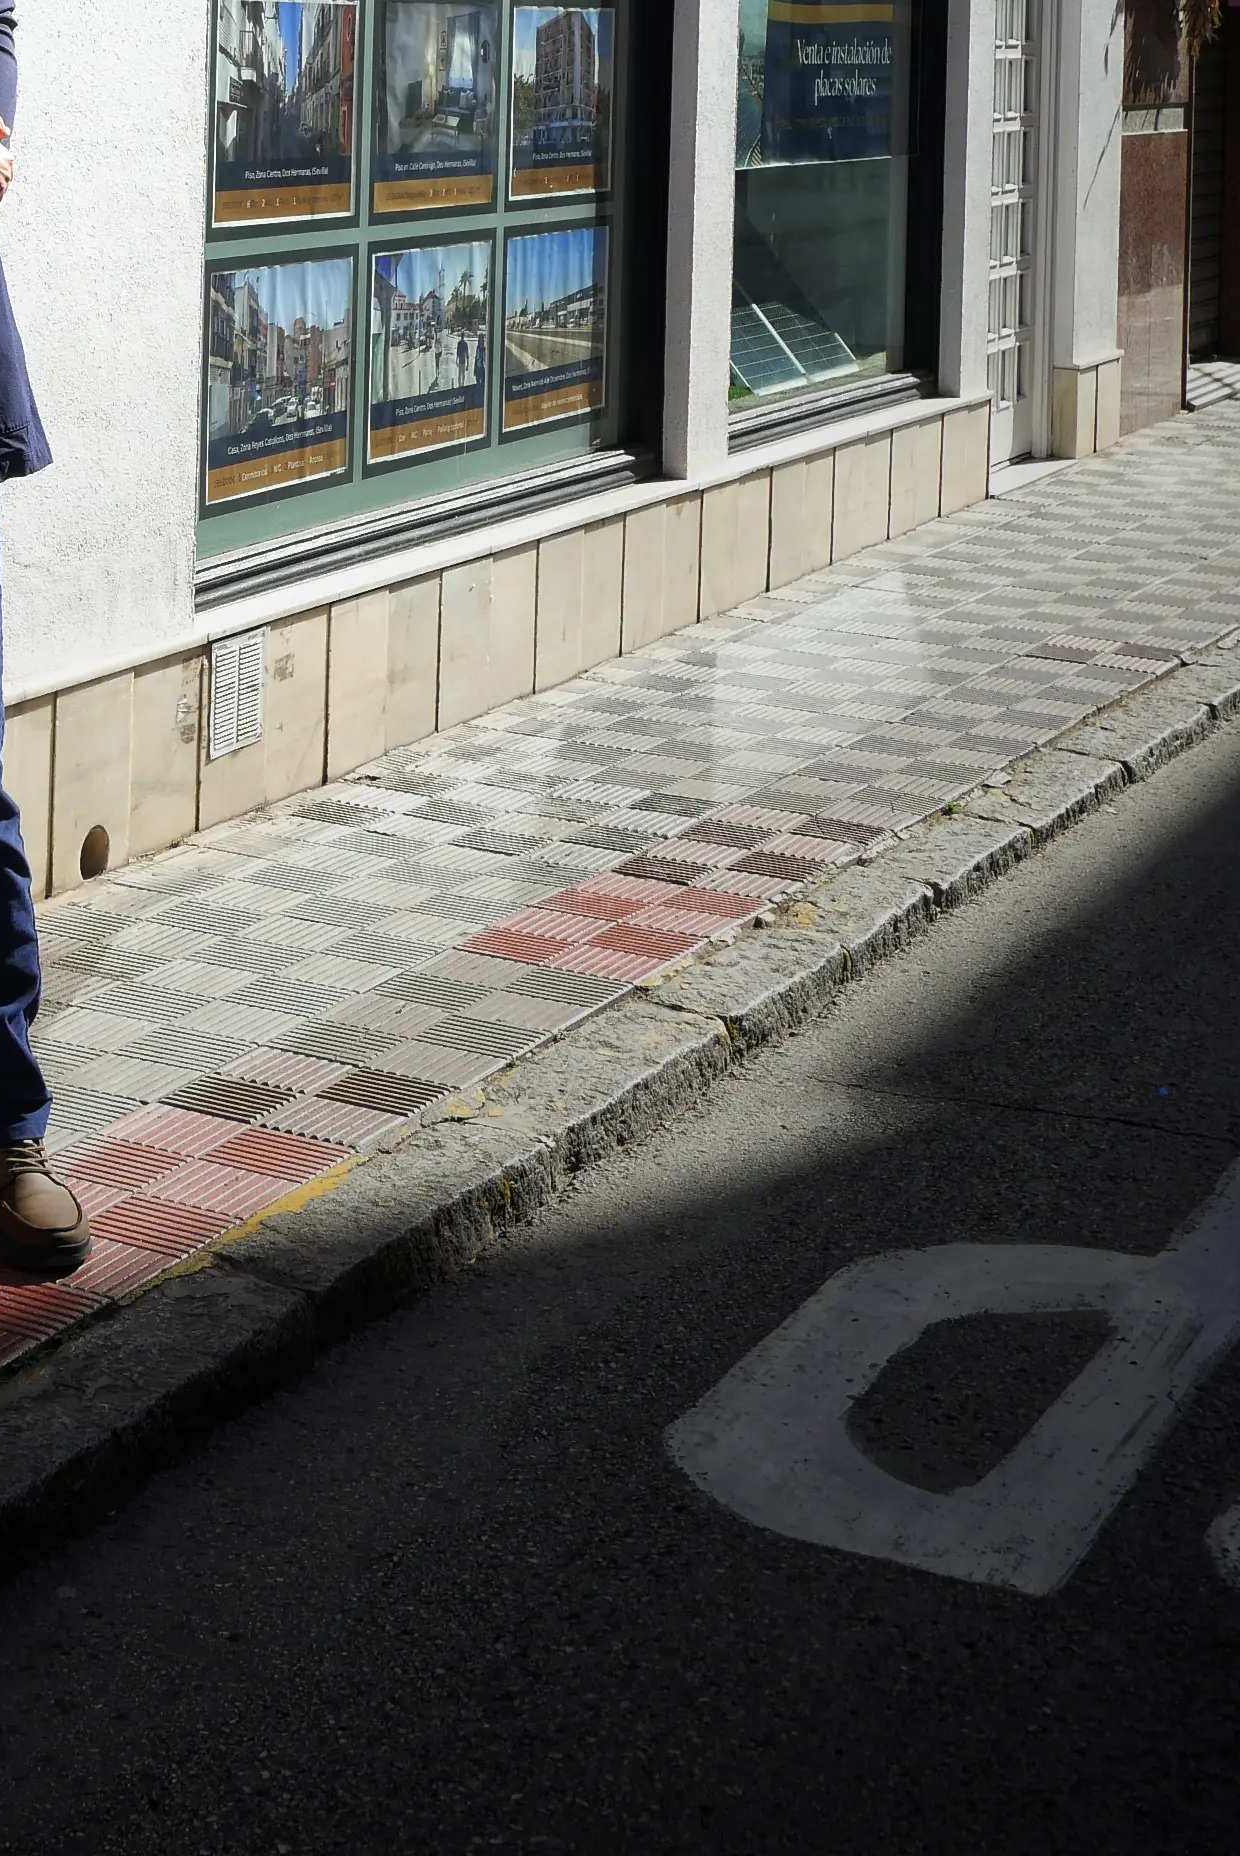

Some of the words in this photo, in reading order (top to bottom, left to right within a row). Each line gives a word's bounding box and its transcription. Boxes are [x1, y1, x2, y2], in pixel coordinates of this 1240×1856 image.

[797, 39, 823, 65] Venta
[824, 46, 830, 64] e
[831, 37, 880, 65] instalación
[880, 38, 891, 65] de
[814, 69, 843, 106] placas
[844, 69, 876, 96] solares
